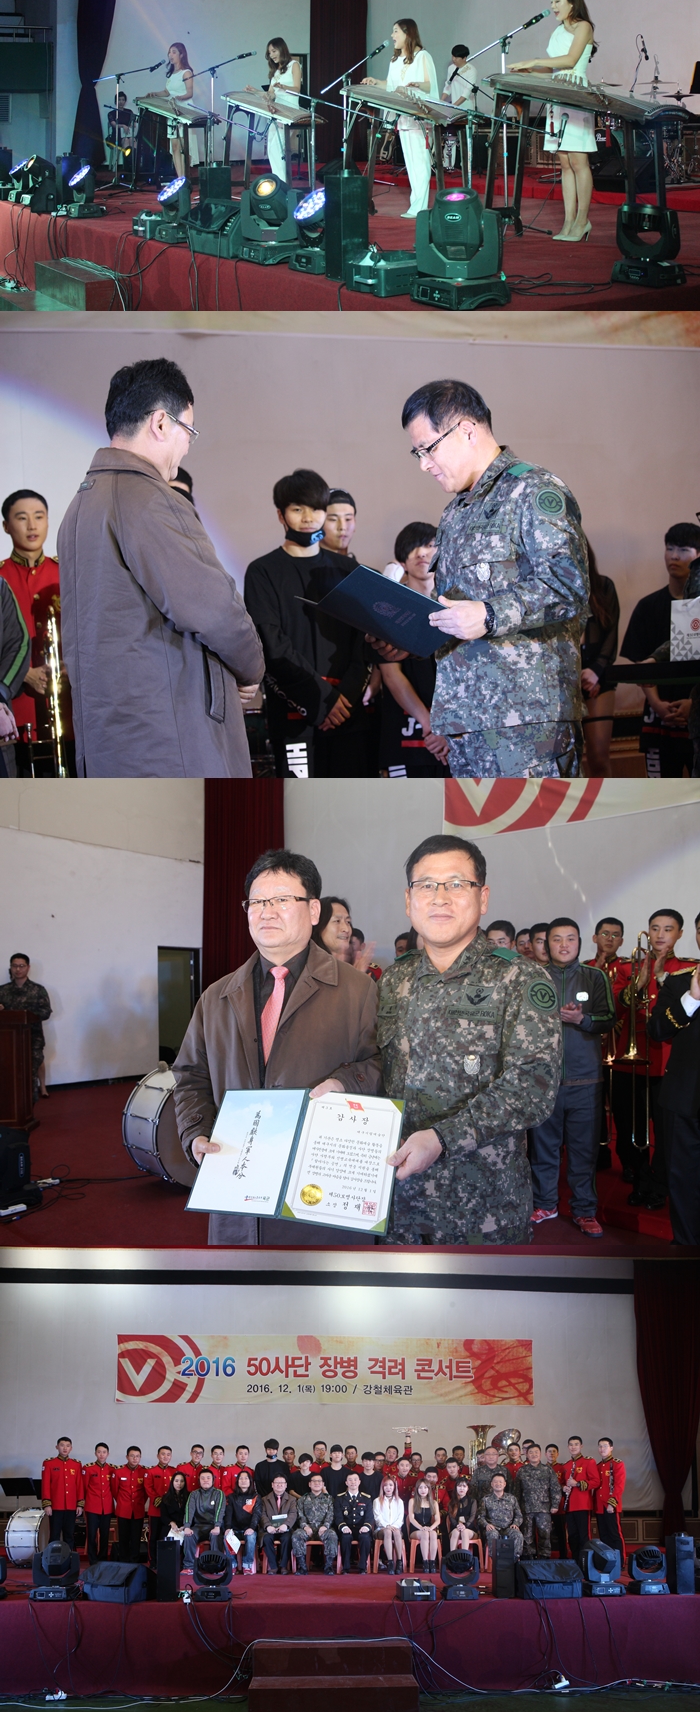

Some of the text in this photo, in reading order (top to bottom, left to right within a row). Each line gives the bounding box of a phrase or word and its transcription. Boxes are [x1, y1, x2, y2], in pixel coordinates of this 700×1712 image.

[181, 1356, 473, 1380] 2016 50사단 장병 격려 콘서트
[246, 1384, 273, 1393] 2016.
[279, 1384, 292, 1393] 12.
[297, 1384, 316, 1393] 1(목)
[321, 1384, 347, 1393] 19:00
[363, 1384, 413, 1395] 강철체육관
